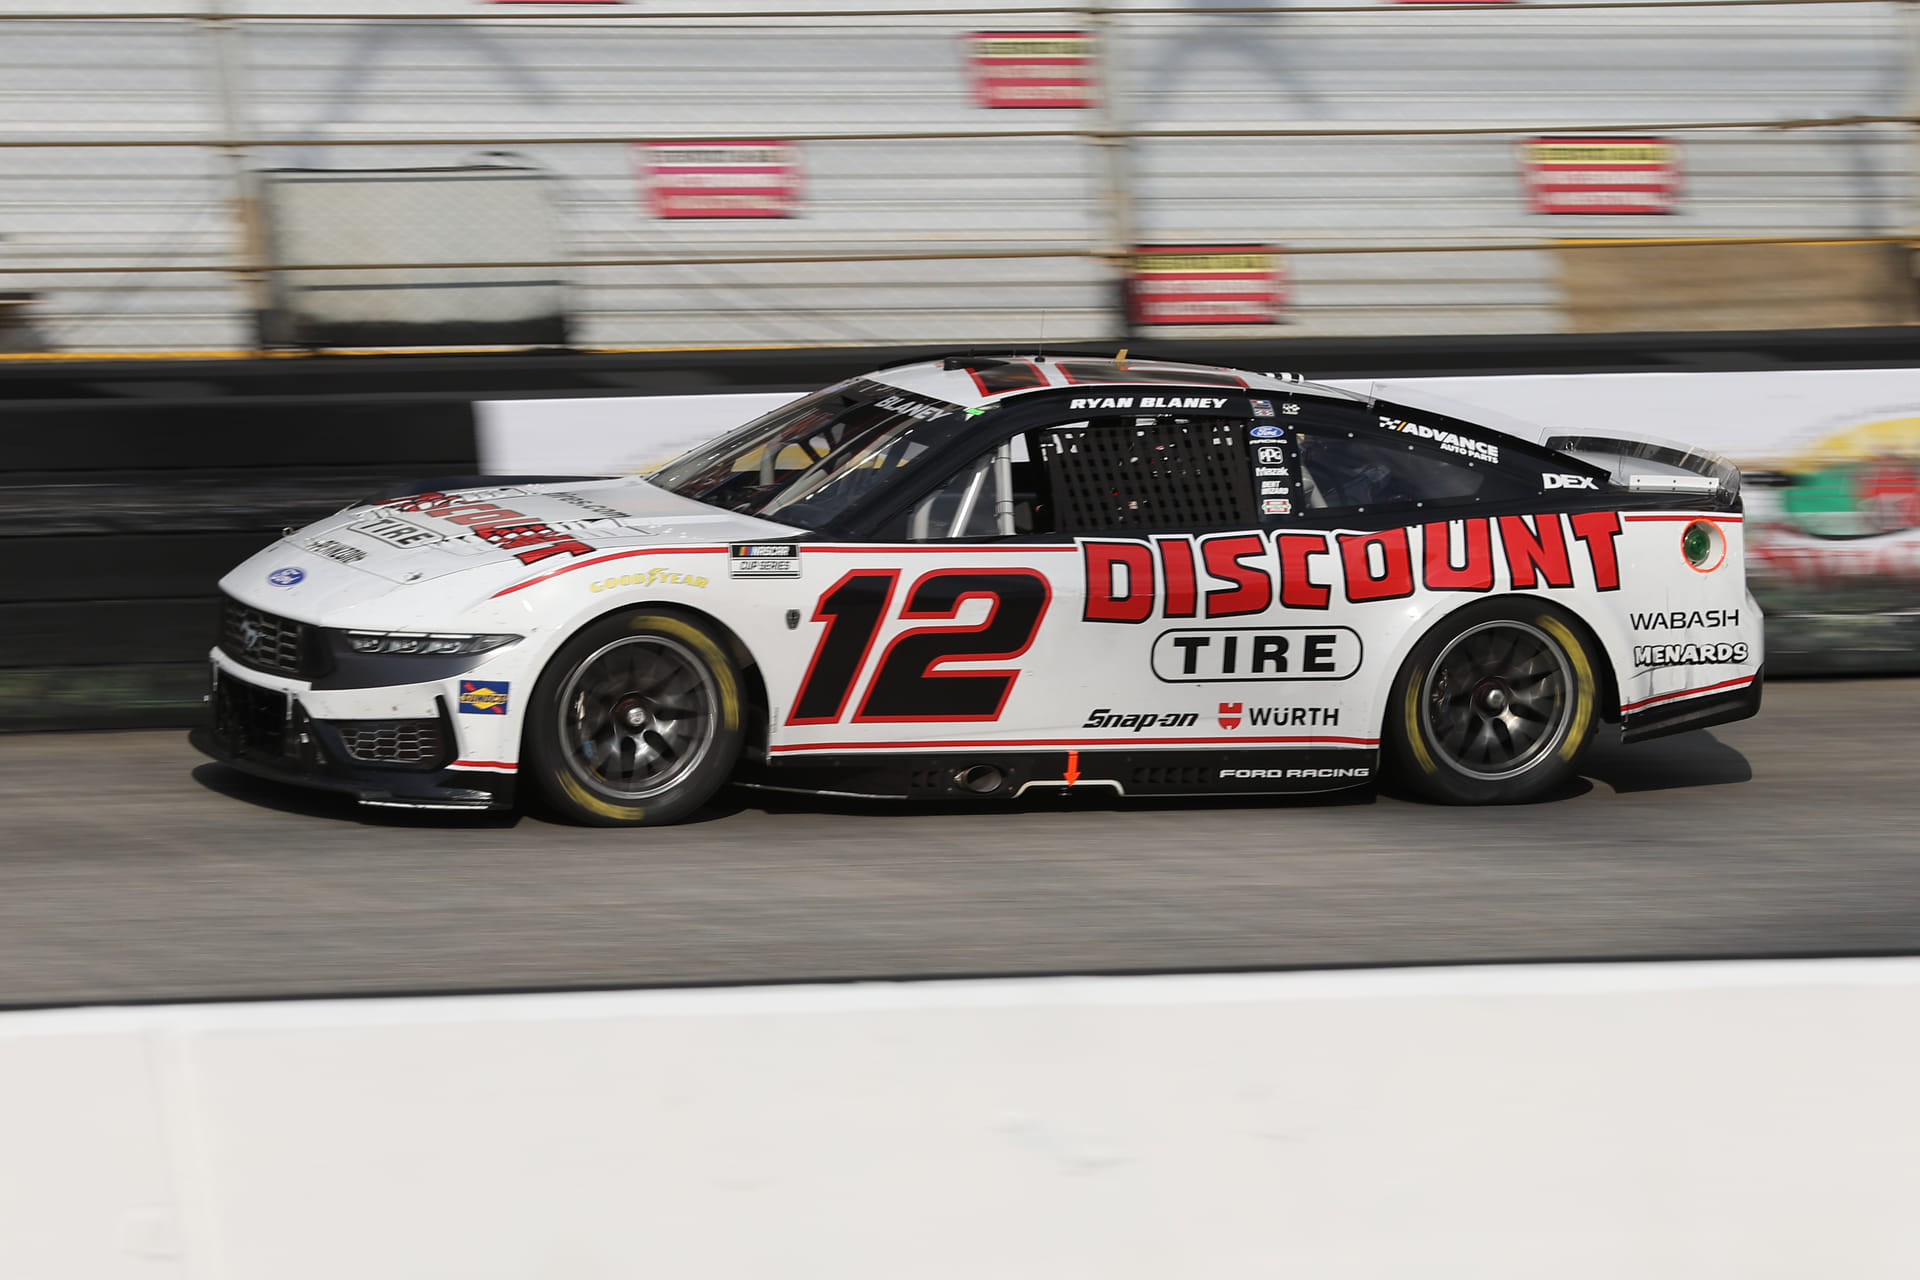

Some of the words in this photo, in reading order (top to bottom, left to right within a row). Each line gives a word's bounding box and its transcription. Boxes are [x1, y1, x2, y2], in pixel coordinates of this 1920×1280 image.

[873, 395, 953, 422] BLANEY
[1069, 398, 1135, 409] RYAN
[1139, 398, 1228, 409] BLANEY
[1254, 427, 1281, 437] Ford
[1401, 421, 1499, 457] ADVANCE
[1259, 448, 1282, 462] PPG
[1439, 442, 1467, 456] AUTO
[1467, 449, 1499, 464] PARTS
[1542, 473, 1600, 490] DEX
[360, 519, 436, 545] TIRE
[1081, 511, 1624, 624] DISCOUNT
[589, 568, 710, 593] GOODYEAR
[1630, 609, 1740, 630] WABASH
[784, 567, 1053, 726] 12
[1173, 634, 1337, 675] TIRE
[1634, 642, 1749, 667] MENARDS
[1082, 709, 1200, 732] Snap-on
[1219, 769, 1283, 778] FORD
[1286, 768, 1370, 778] RACING
